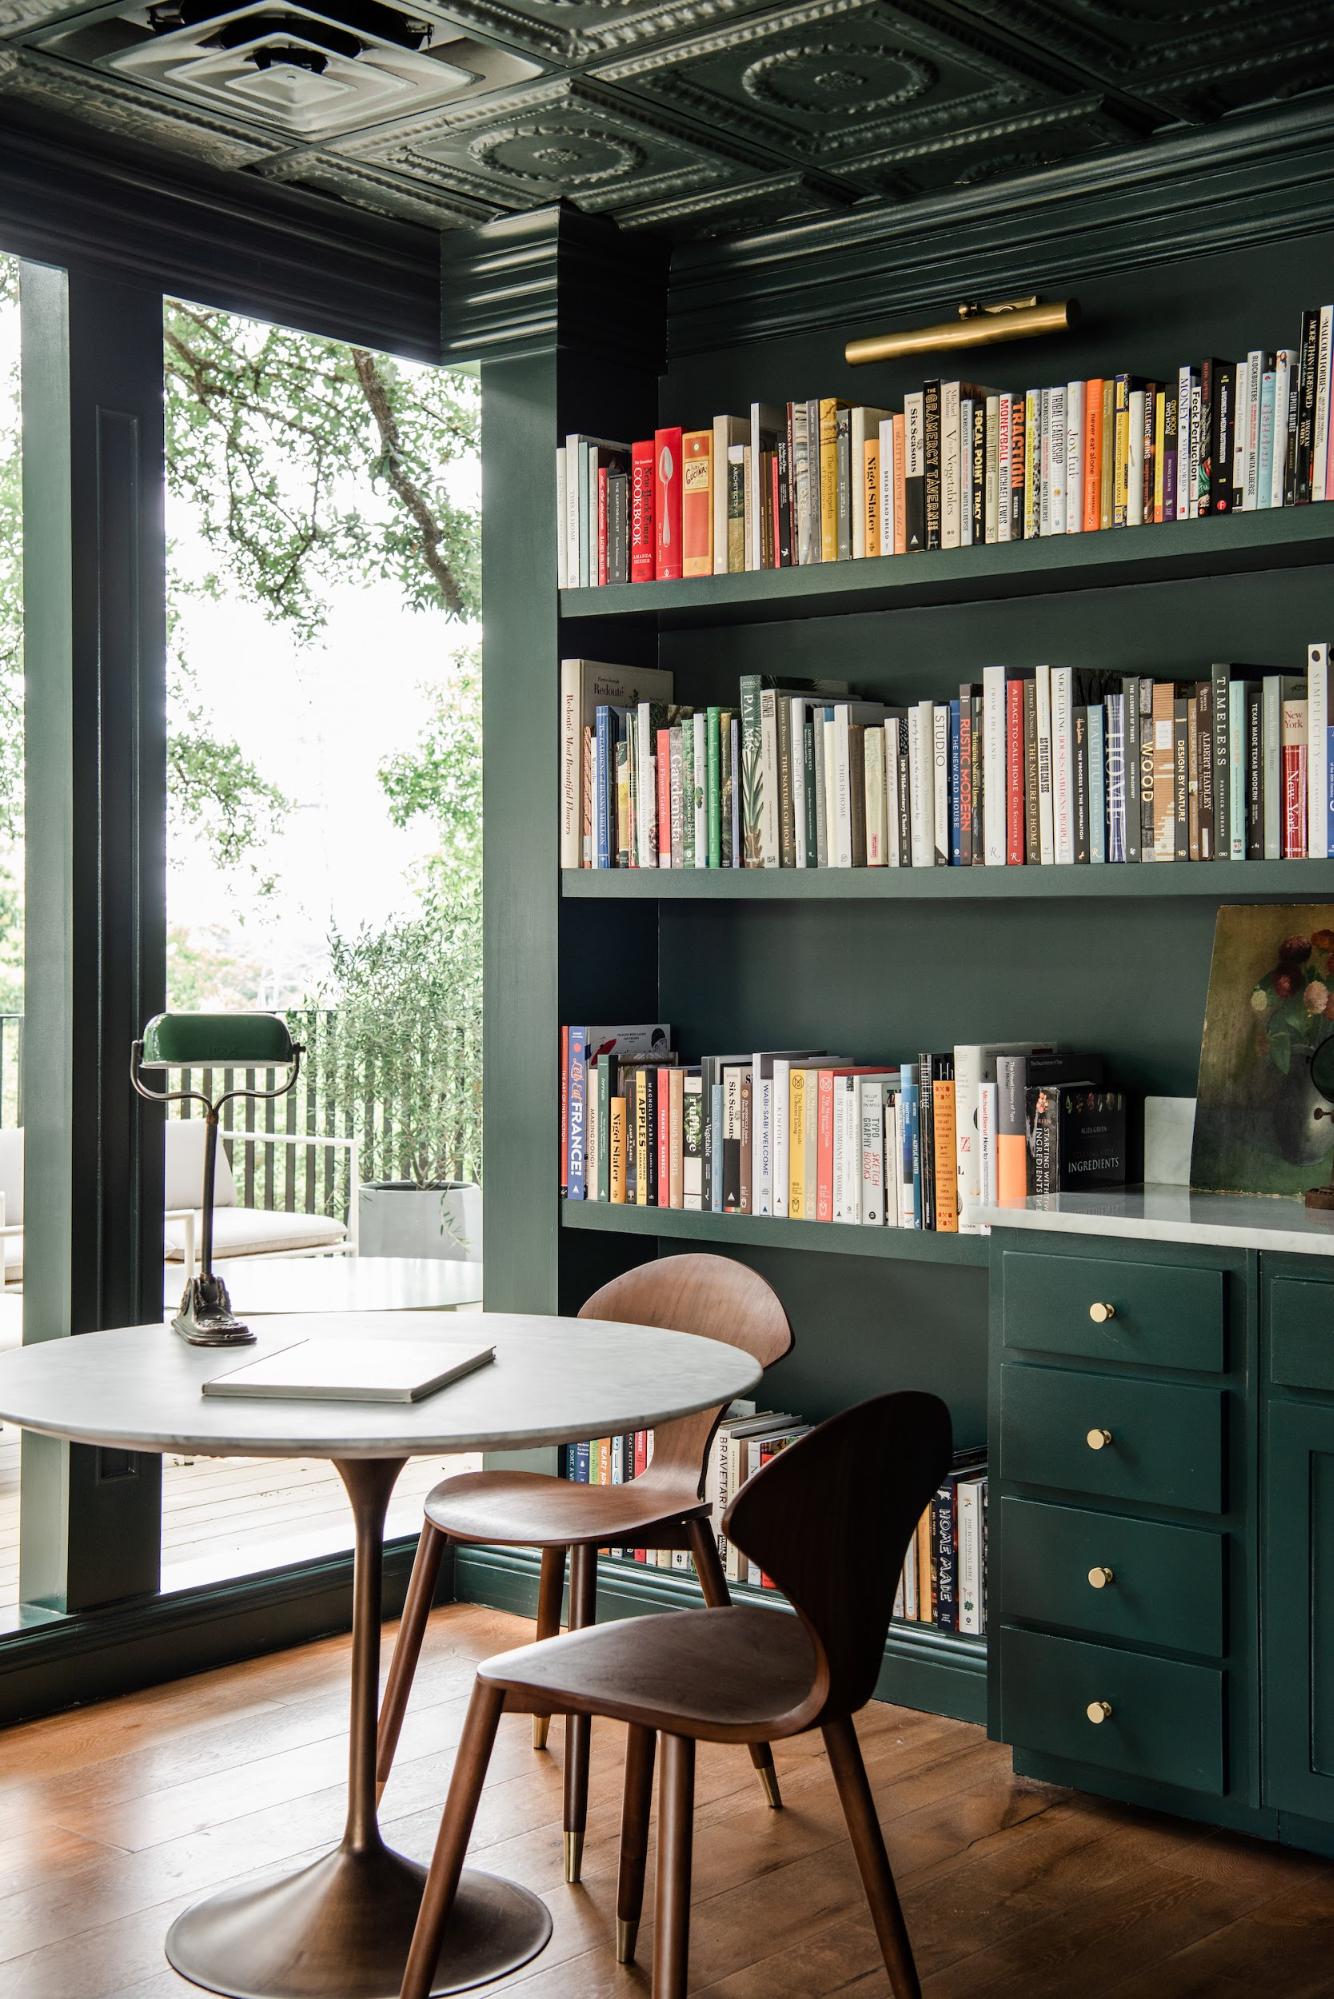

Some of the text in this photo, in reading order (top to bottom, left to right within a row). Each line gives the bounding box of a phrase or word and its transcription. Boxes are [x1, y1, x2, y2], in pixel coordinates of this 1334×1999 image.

[1307, 343, 1315, 367] THAN
[1308, 319, 1317, 342] MORE
[1320, 321, 1328, 360] MALCOLM
[1180, 378, 1188, 422] MONEY
[1305, 372, 1314, 408] DREAMED
[1319, 360, 1327, 393] FORBES
[1051, 393, 1063, 464] TRIBAL LEADERSHIP
[1144, 392, 1152, 438] EXCELLENCE
[1191, 392, 1199, 481] Feck Perfuction
[926, 394, 939, 521] GRAMERCY TAVERN
[944, 429, 957, 516] V Vegetables
[974, 410, 983, 485] FOCAL POINT
[999, 399, 1009, 524] MONEYBALL MICHAEL LEWIS
[1011, 401, 1024, 488] TRACTION
[633, 468, 642, 546] COOKBOOK
[866, 457, 876, 533] Nigel Slater
[743, 694, 754, 752] PALMS
[763, 694, 774, 718] WEGNER
[1012, 727, 1018, 739] TO
[1216, 677, 1226, 766] TIMELESS
[1284, 719, 1304, 728] York
[1285, 711, 1303, 719] New
[1312, 673, 1320, 758] SIMPLICITY
[565, 695, 574, 835] Redouté Most Beautiful Flowers
[935, 715, 945, 767] STUDIO
[1090, 714, 1100, 789] BEAUTIFUL
[672, 754, 682, 842] Gardenista
[960, 719, 970, 831] RUSTIC MODERN
[1029, 764, 1037, 801] NATURE
[1105, 732, 1125, 824] HOME
[1141, 741, 1153, 802] WOOD
[1178, 775, 1185, 786] BY
[1203, 771, 1211, 809] HADLEY
[1030, 804, 1037, 816] OF
[1286, 770, 1298, 833] New York
[570, 1102, 582, 1175] FRANCE!
[612, 1113, 621, 1182] Nigel Slater
[638, 1098, 646, 1147] APPLES
[688, 1098, 699, 1152] ruffage
[863, 1117, 871, 1148] GRAPHY
[871, 1118, 880, 1138] TYPO
[871, 1152, 880, 1186] SKETCH
[1068, 1157, 1120, 1173] INGREDIENTS
[939, 1509, 952, 1602] HOME MADE
